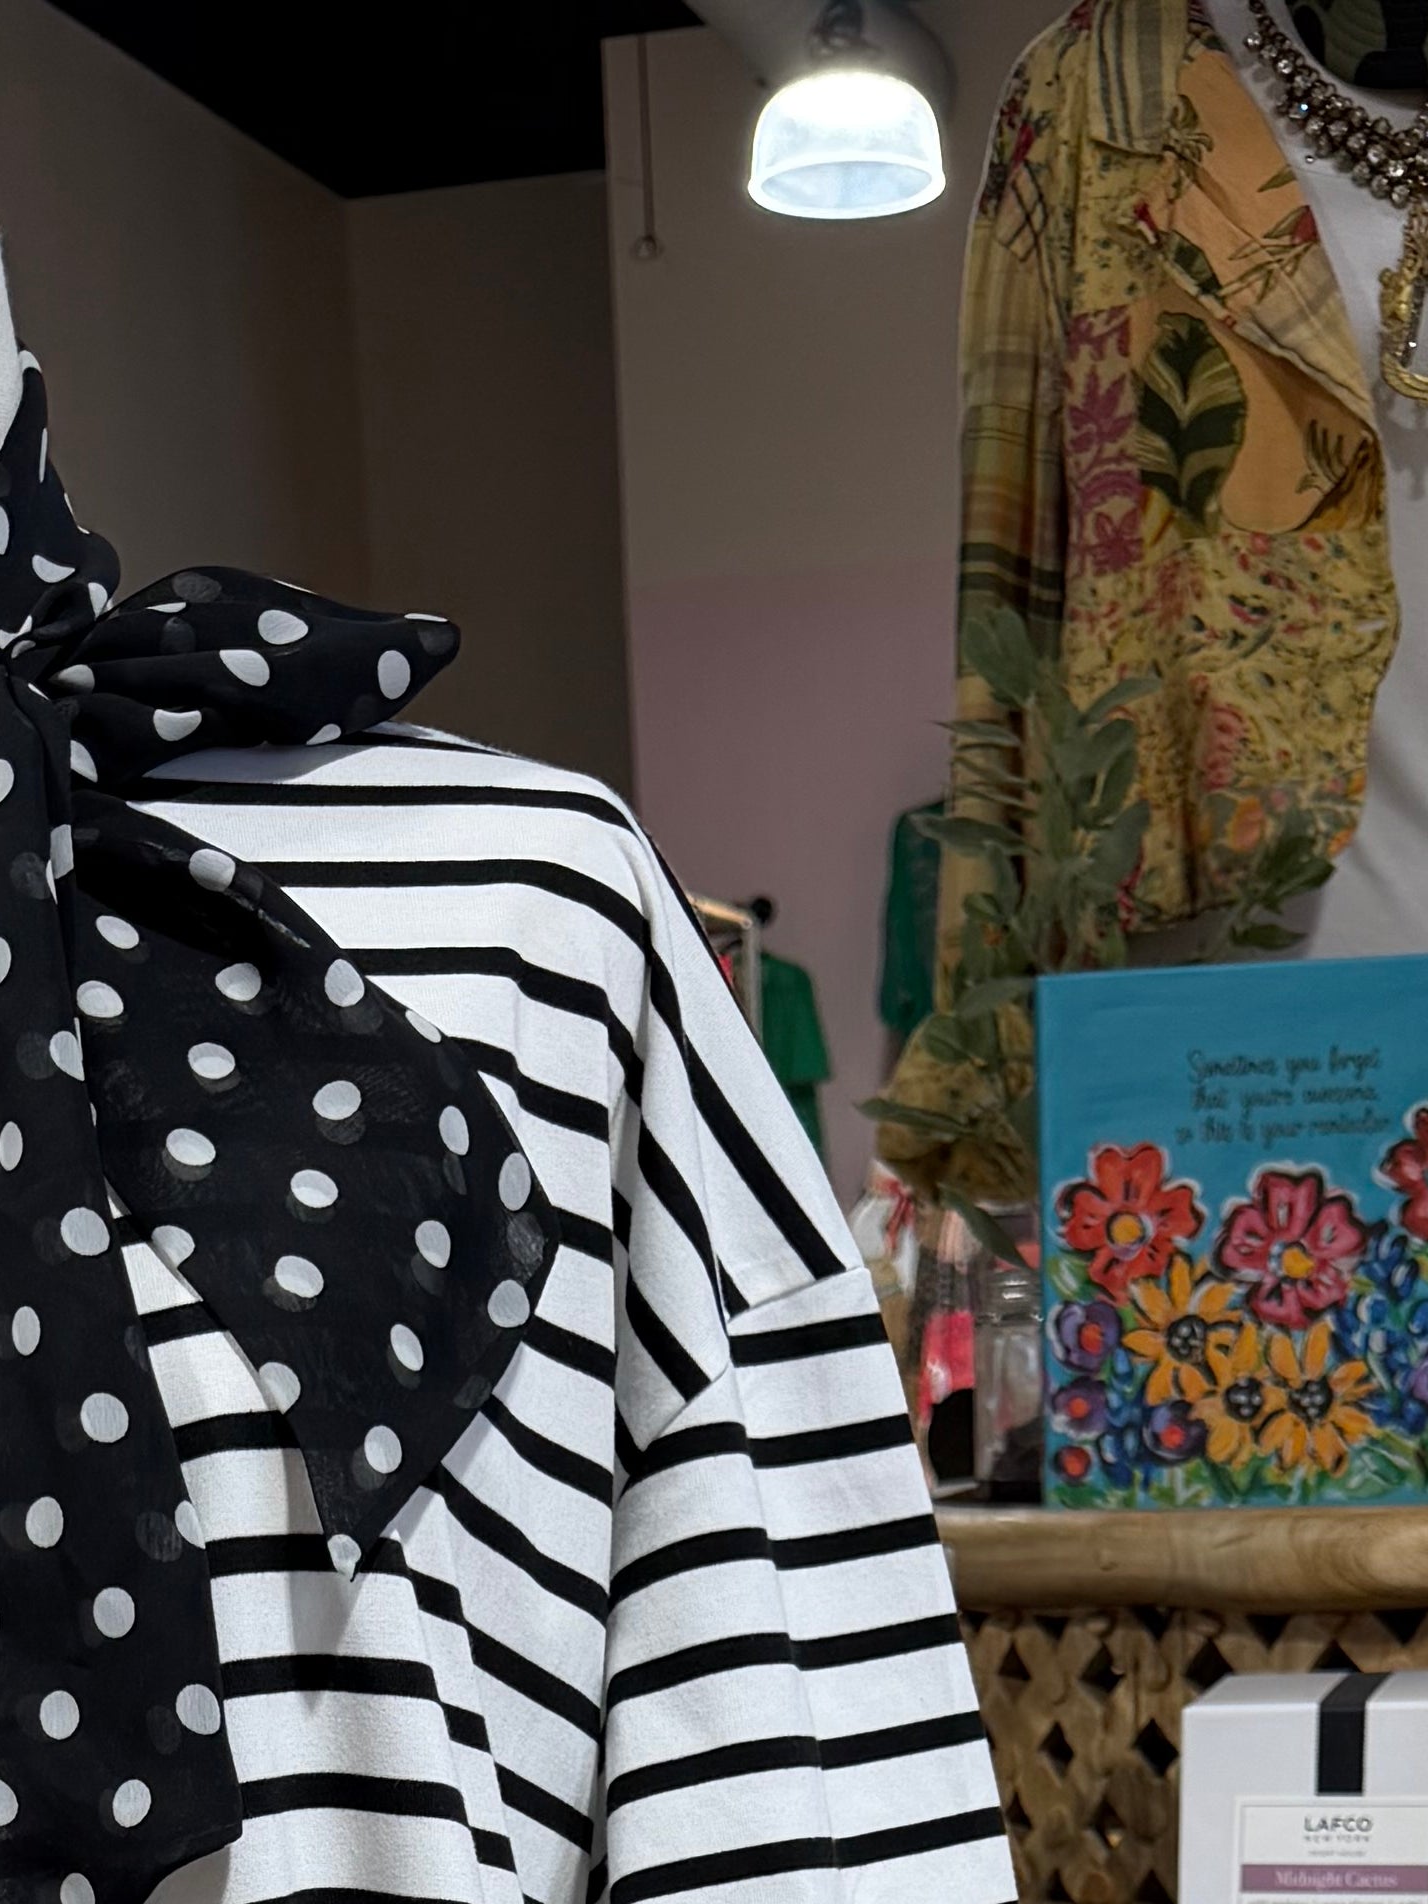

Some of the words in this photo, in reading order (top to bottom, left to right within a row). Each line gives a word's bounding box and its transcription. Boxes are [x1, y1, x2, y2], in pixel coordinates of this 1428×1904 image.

[1286, 1058, 1320, 1085] you
[1304, 1816, 1373, 1832] LAFCO
[1276, 1871, 1342, 1890] Midnight
[1345, 1871, 1398, 1888] Cactus
